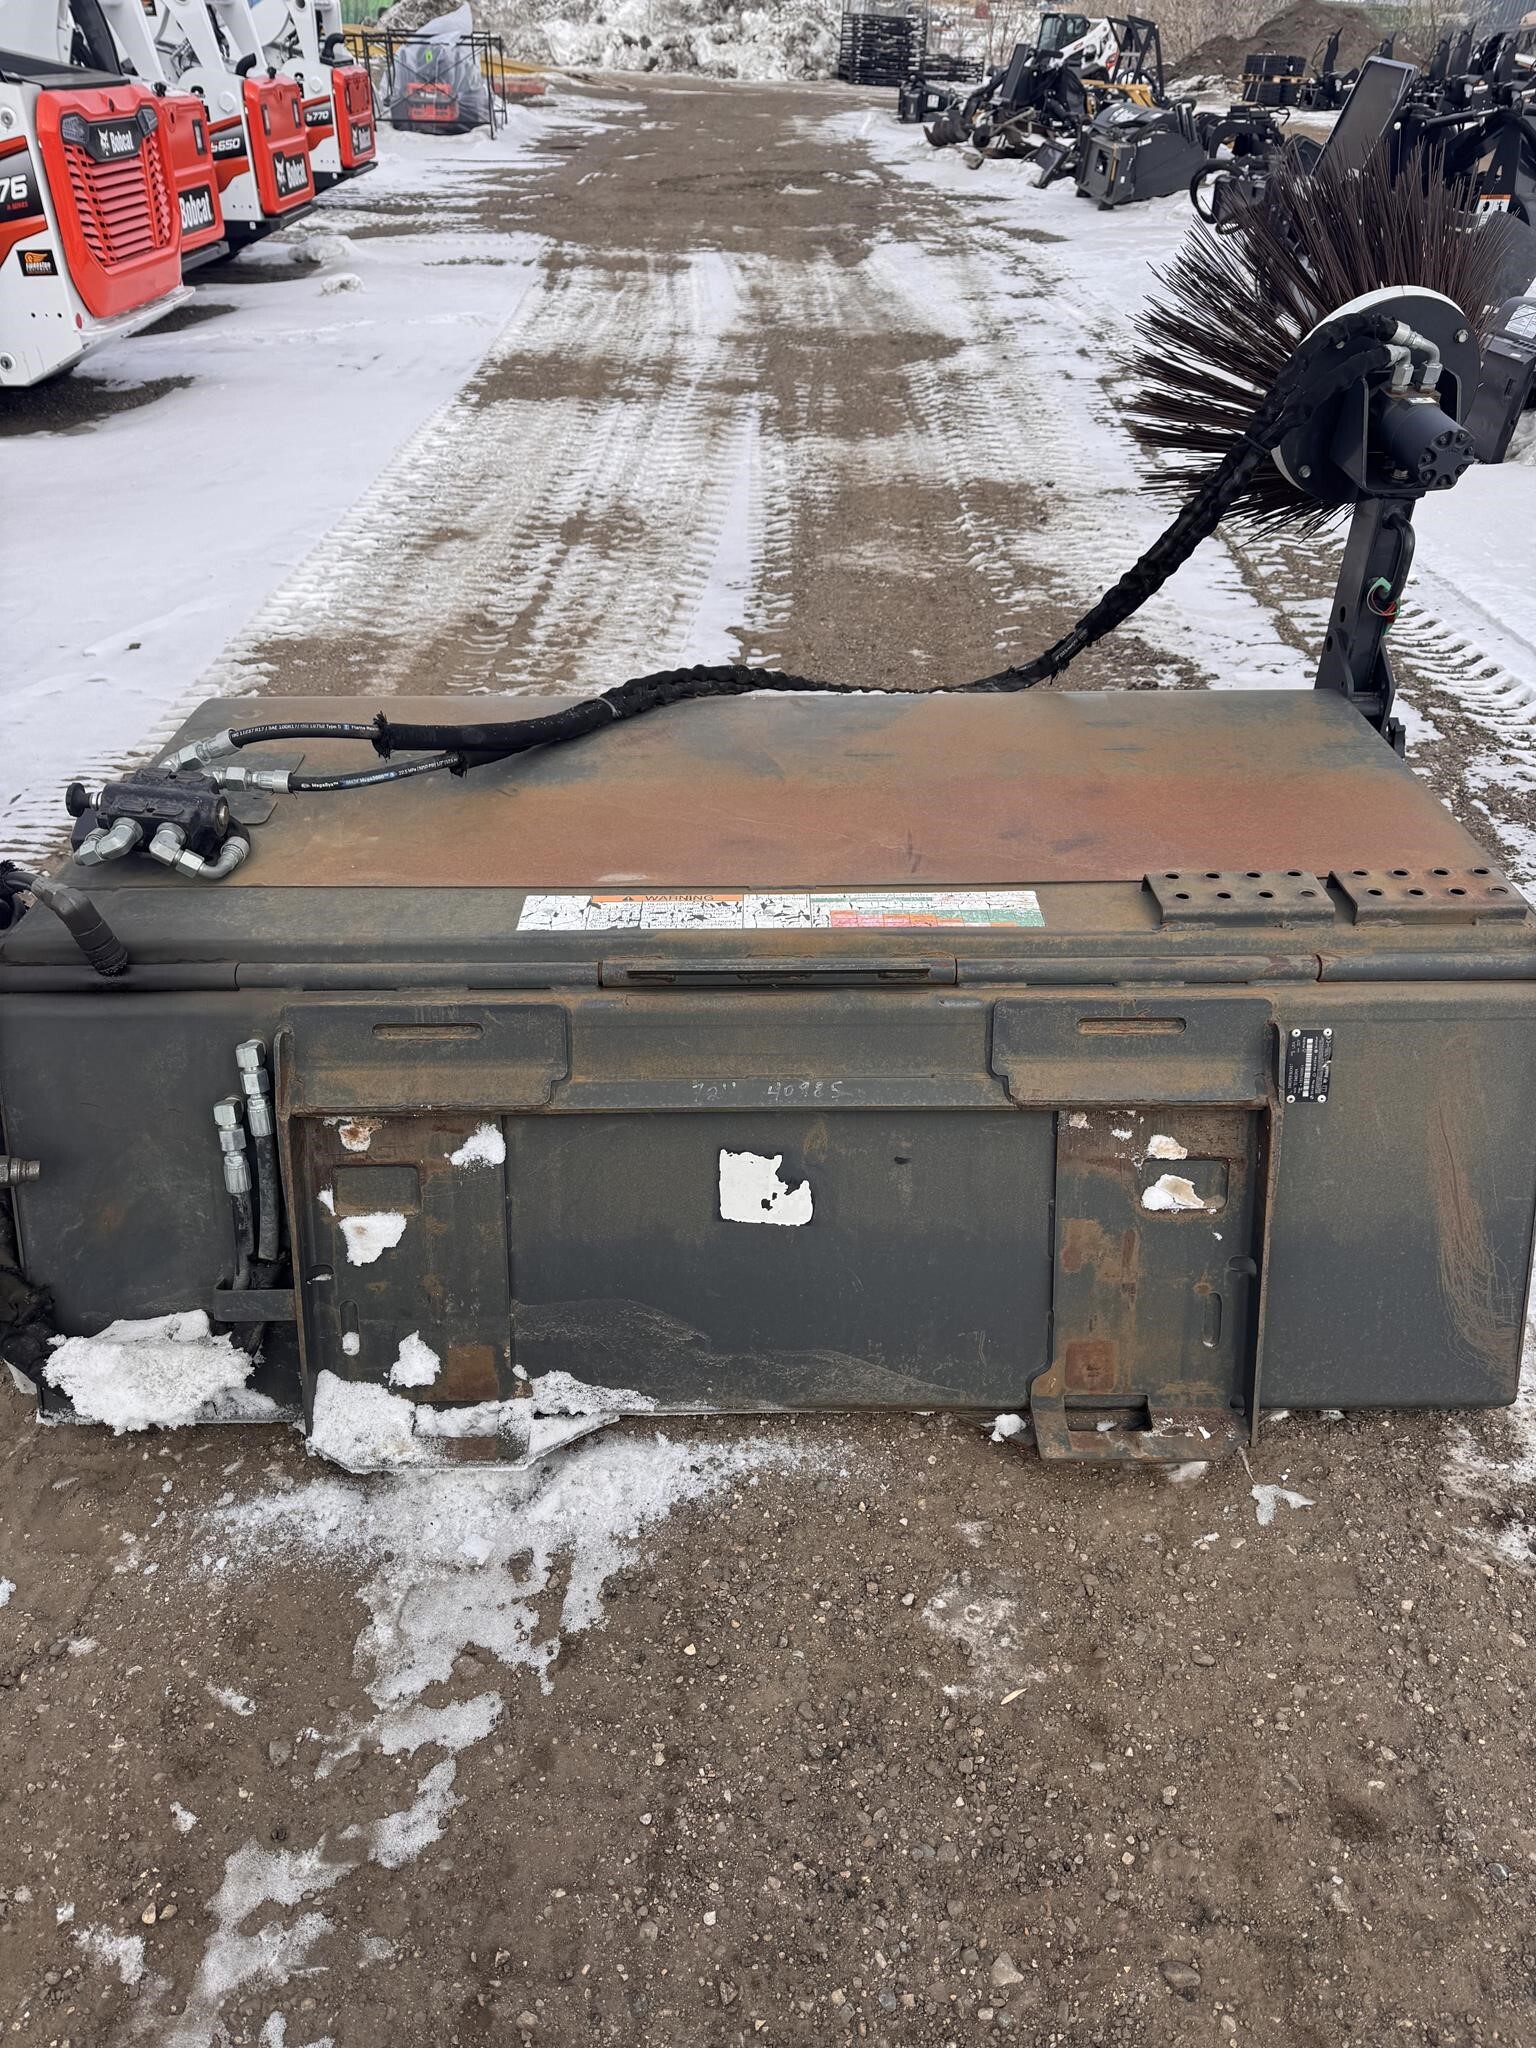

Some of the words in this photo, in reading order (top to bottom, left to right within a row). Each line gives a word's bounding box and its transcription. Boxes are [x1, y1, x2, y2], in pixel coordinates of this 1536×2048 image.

[109, 130, 135, 154] Bobcat
[286, 158, 308, 189] Bobcat
[178, 191, 213, 230] Bobcat
